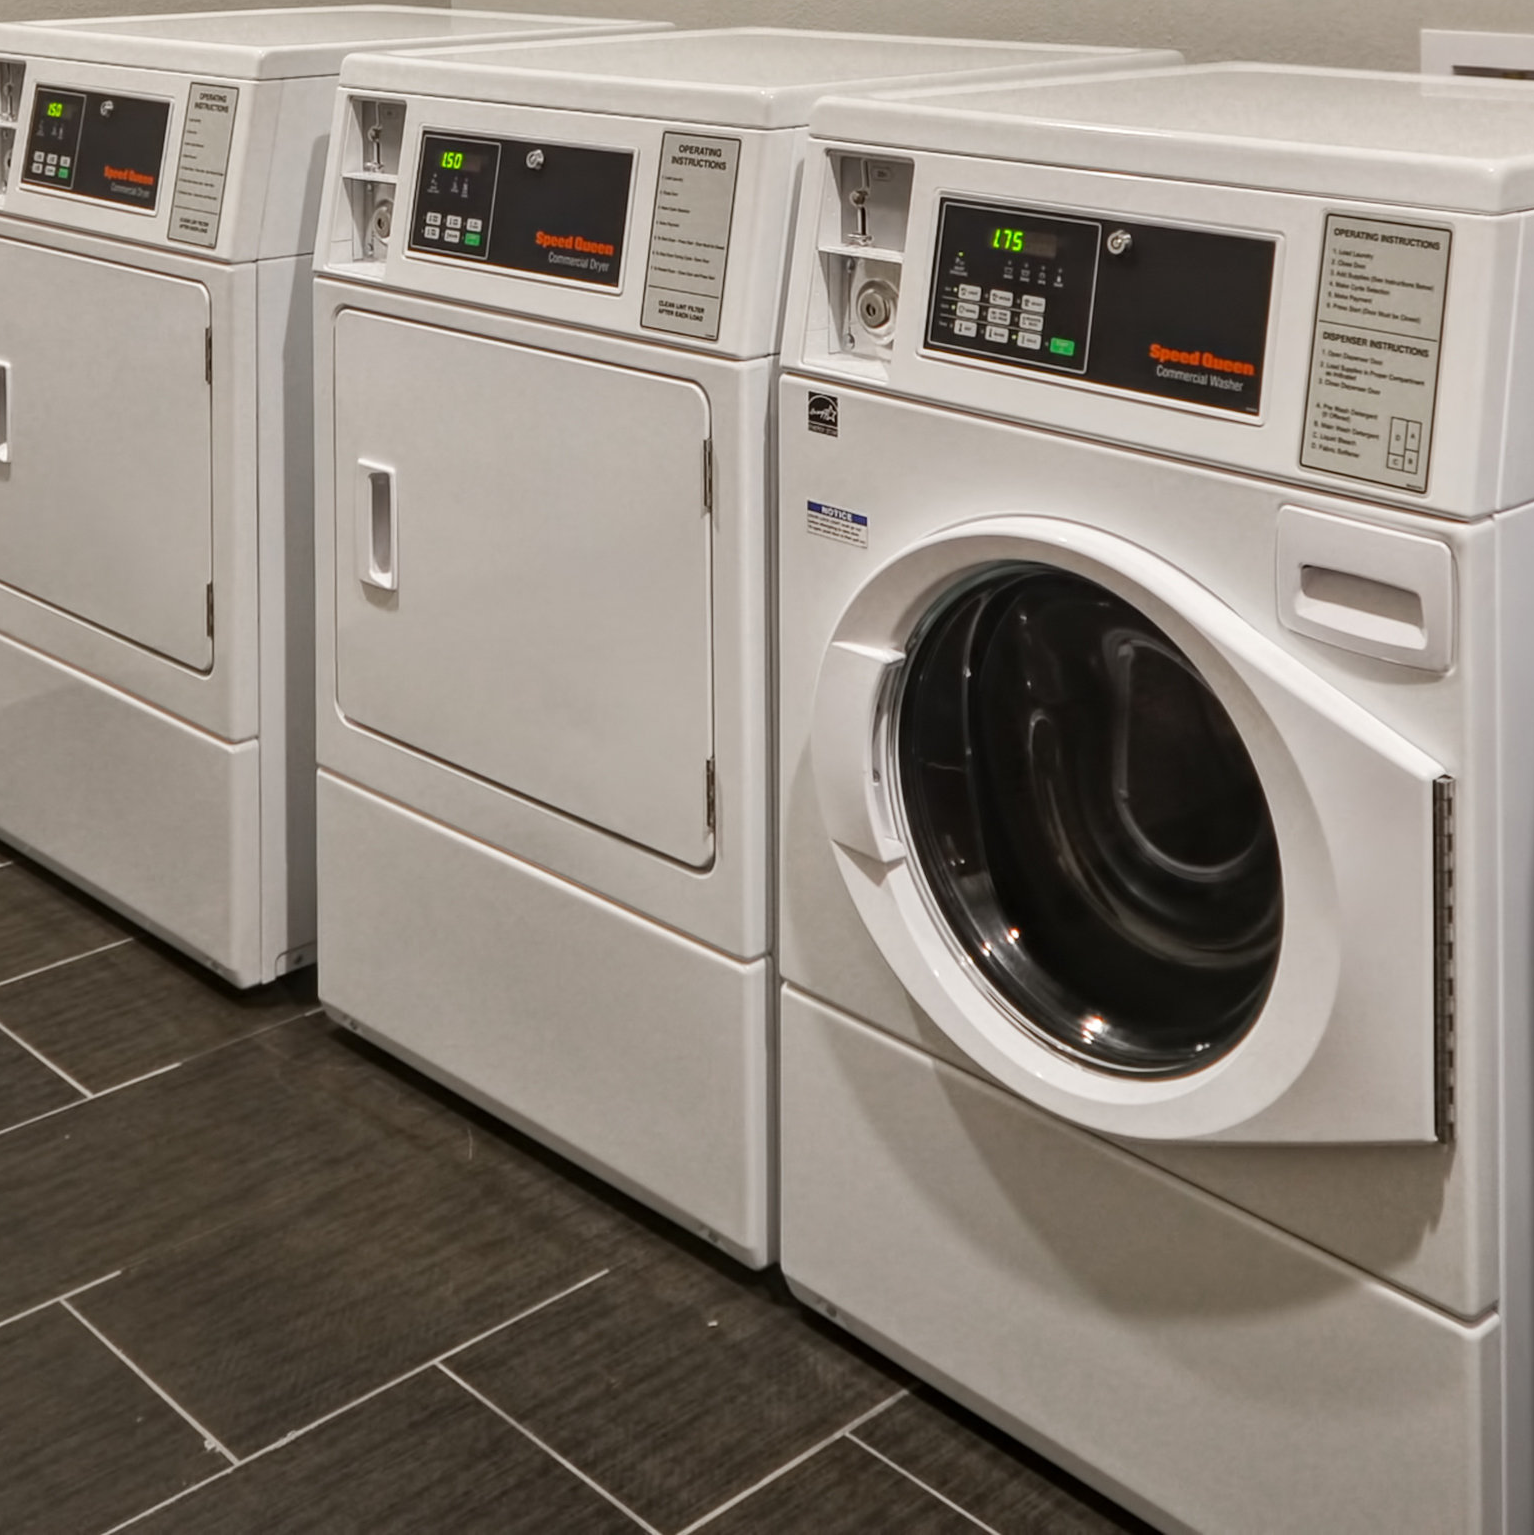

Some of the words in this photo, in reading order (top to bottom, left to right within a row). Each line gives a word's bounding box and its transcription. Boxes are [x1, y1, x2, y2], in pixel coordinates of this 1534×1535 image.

[679, 144, 722, 157] OPERATING
[671, 156, 726, 170] INSTRUCTIONS
[535, 231, 573, 250] Speed
[574, 237, 614, 256] Queen
[1334, 228, 1378, 241] OPERATING
[1381, 235, 1440, 250] INSTRUCTIONS
[548, 252, 589, 269] Commercial
[590, 259, 609, 272] Dryer
[1323, 331, 1367, 345] DISPENSER
[1370, 340, 1429, 357] INSTRUCTIONS
[1149, 343, 1200, 365] Speed
[1202, 352, 1255, 376] Queen
[1156, 365, 1208, 385] Commercial
[1210, 375, 1243, 392] Washer
[821, 505, 852, 522] NOTICE
